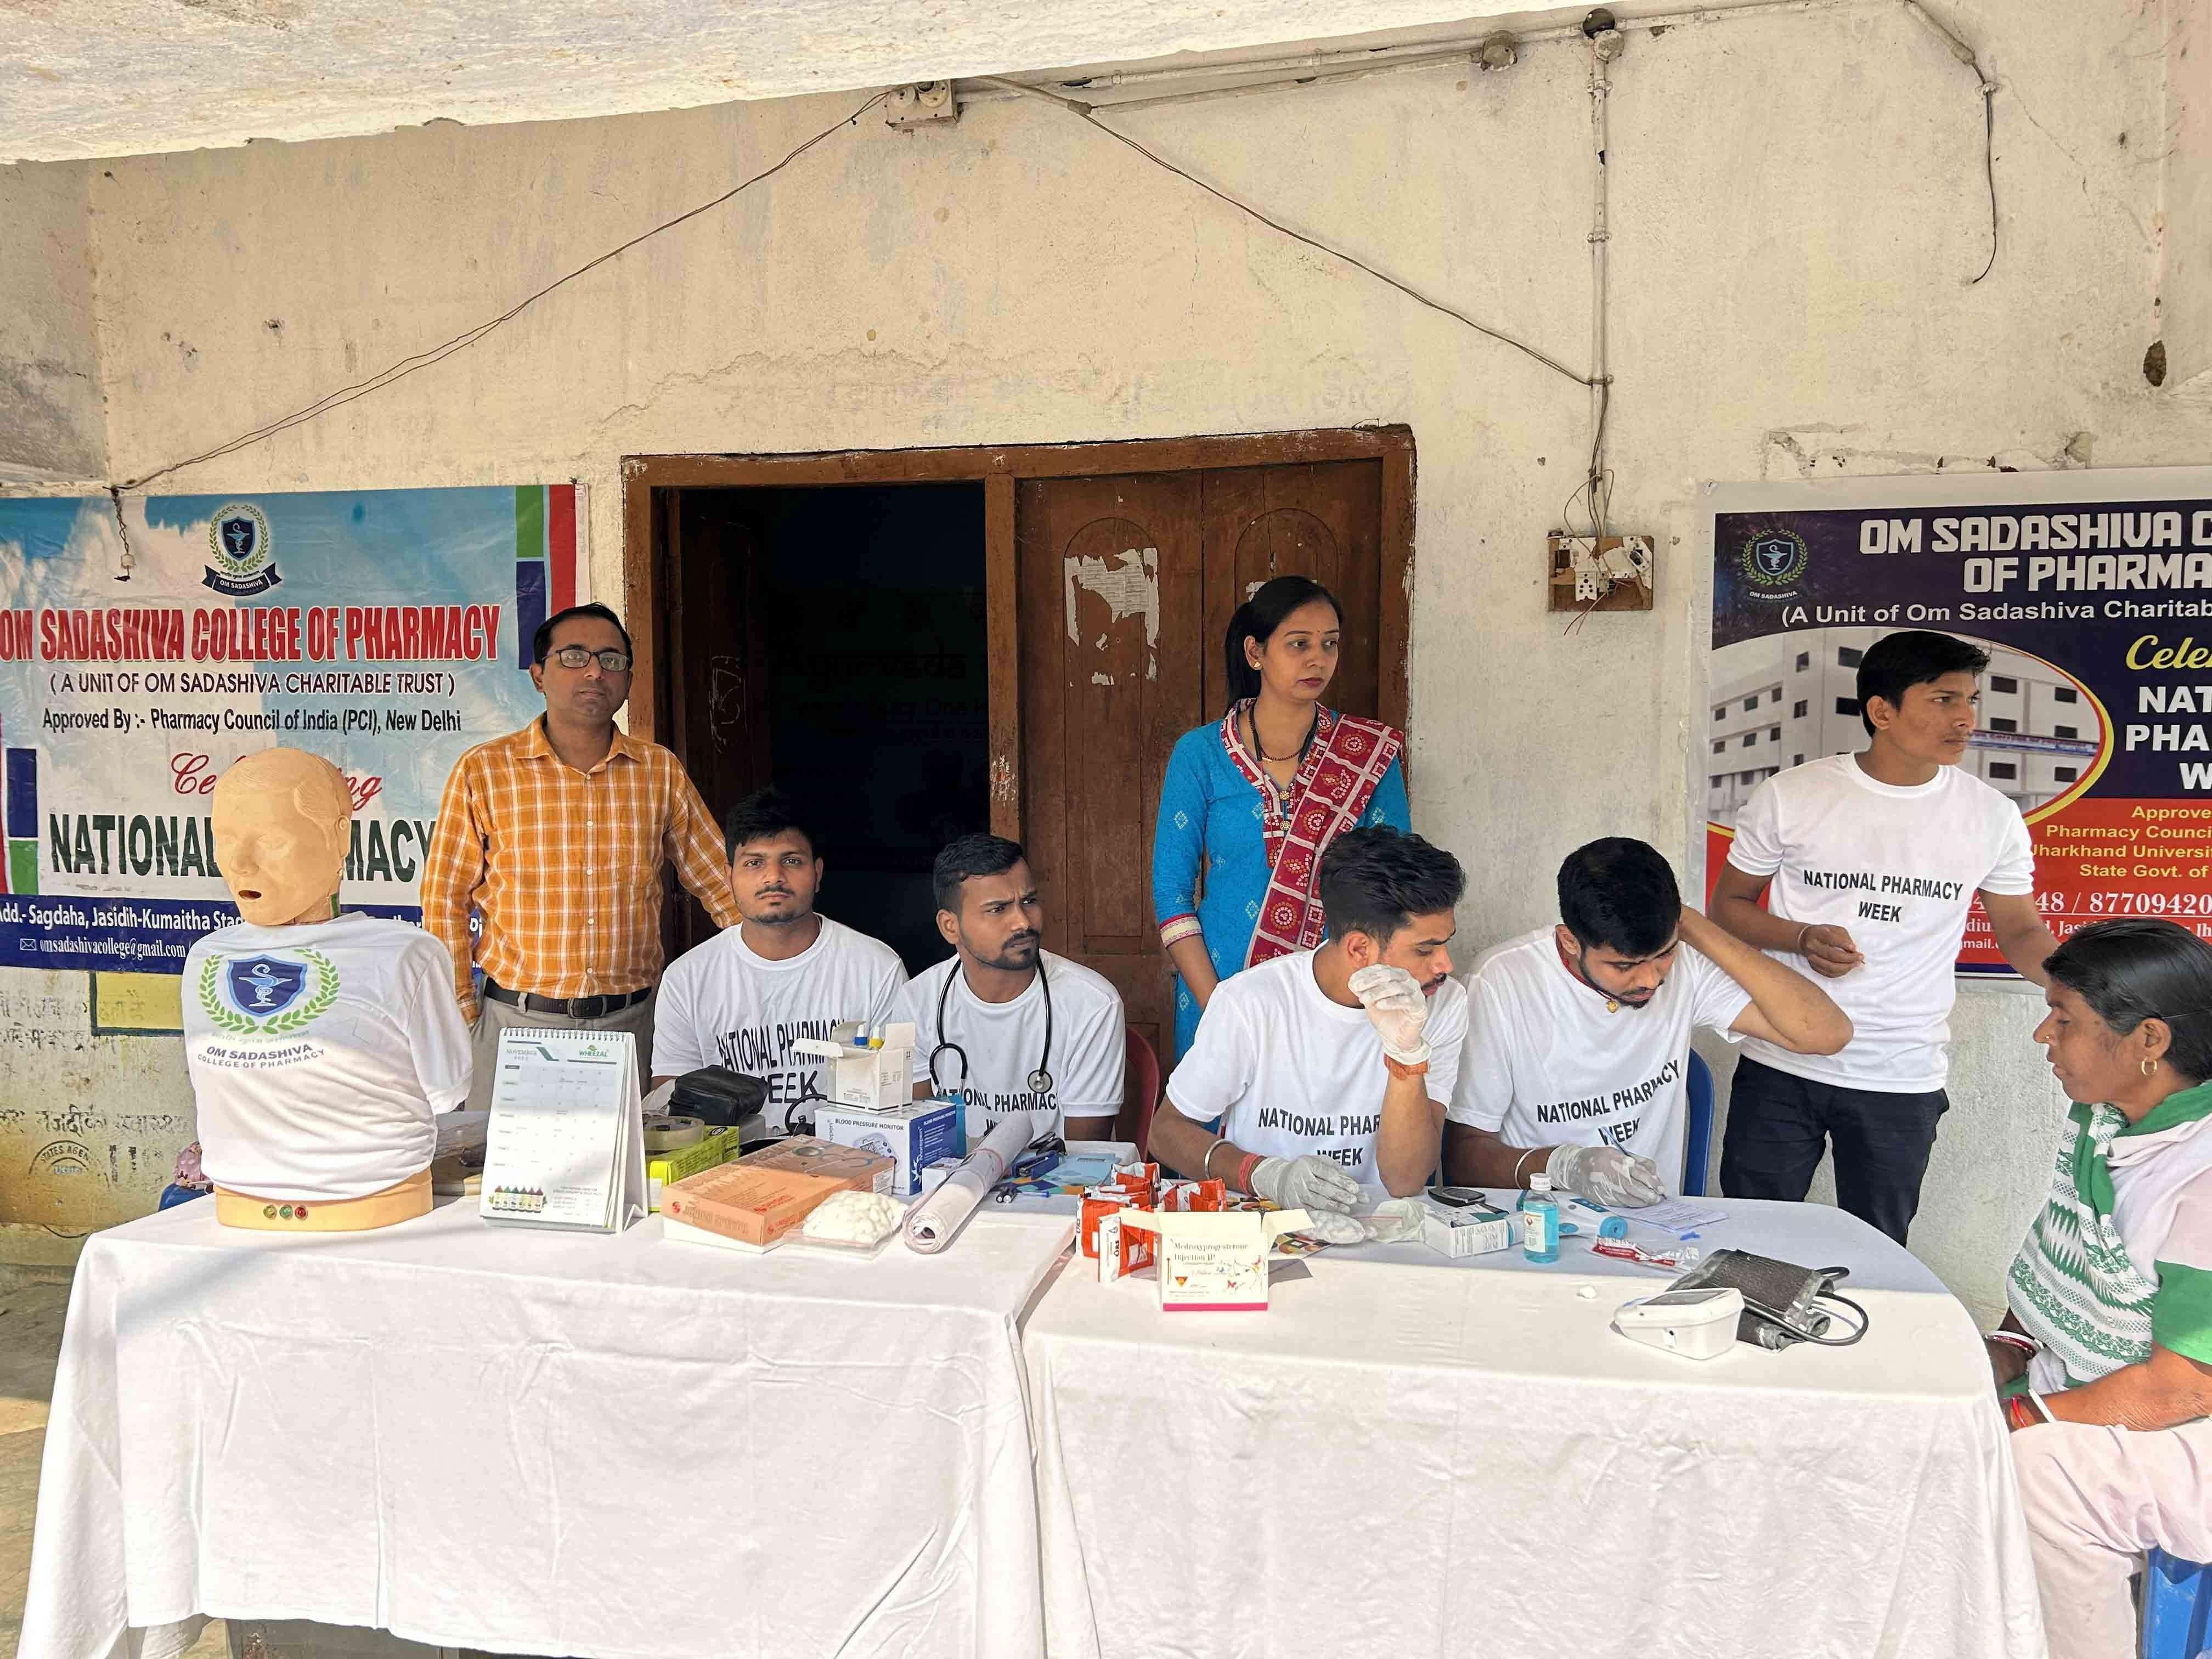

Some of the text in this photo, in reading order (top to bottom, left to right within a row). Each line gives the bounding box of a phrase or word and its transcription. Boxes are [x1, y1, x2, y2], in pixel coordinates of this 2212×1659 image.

[1860, 519, 1922, 554] OM
[1932, 511, 2182, 552] SADASHIVA
[231, 579, 263, 589] SADASHIVA
[1964, 552, 2212, 592] OF PHARMA
[1760, 591, 1797, 599] SADASHIVA
[1782, 599, 2212, 627] (A Unit of Om Sadashiva Charitab
[0, 604, 500, 663] OM SADASHIVA COLLEGE OF PHARMACY
[61, 677, 75, 693] A
[78, 675, 114, 692] UNIT
[116, 675, 140, 692] OF
[144, 674, 176, 693] OM
[180, 674, 280, 693] SADASHIVA
[285, 673, 392, 693] CHARITABLE
[397, 673, 442, 693] TRUST
[42, 707, 109, 731] Approved
[113, 708, 132, 731] By
[151, 708, 220, 731] Pharmacy
[224, 708, 280, 730] Council
[284, 708, 299, 730] of
[302, 708, 338, 730] India
[342, 708, 381, 732] (PCI),
[386, 709, 416, 730] New
[420, 709, 461, 730] Delhi
[2132, 806, 2212, 821] Approve
[2046, 825, 2212, 841] Pharmacy Counci
[49, 814, 219, 877] NATIONAL
[2032, 844, 2126, 857] Jharkhand
[2080, 864, 2209, 878] State Govt. of
[1803, 870, 1963, 901] NATIONAL PHARMACY
[1858, 901, 1903, 923] WEEK
[2089, 893, 2212, 914] 87709420
[29, 905, 88, 930] Sagdaha,
[92, 906, 210, 930] Jasidih-Kumaitha
[40, 936, 186, 960] omsadashivacollege@gmail.com
[198, 1054, 240, 1068] COLLEGE
[260, 1049, 325, 1069] PHARMACY
[206, 1043, 313, 1060] OM SADASHIVA
[716, 1025, 777, 1071] NATIONAL
[763, 1070, 818, 1104] EEK
[1537, 1059, 1680, 1124] NATIONAL PHARMACY
[994, 1088, 1058, 1112] PHARMAC
[835, 1118, 852, 1126] BLOOD
[853, 1120, 878, 1128] PRESSURE
[1258, 1107, 1380, 1136] NATIONAL PHAR
[1317, 1147, 1363, 1166] EEK
